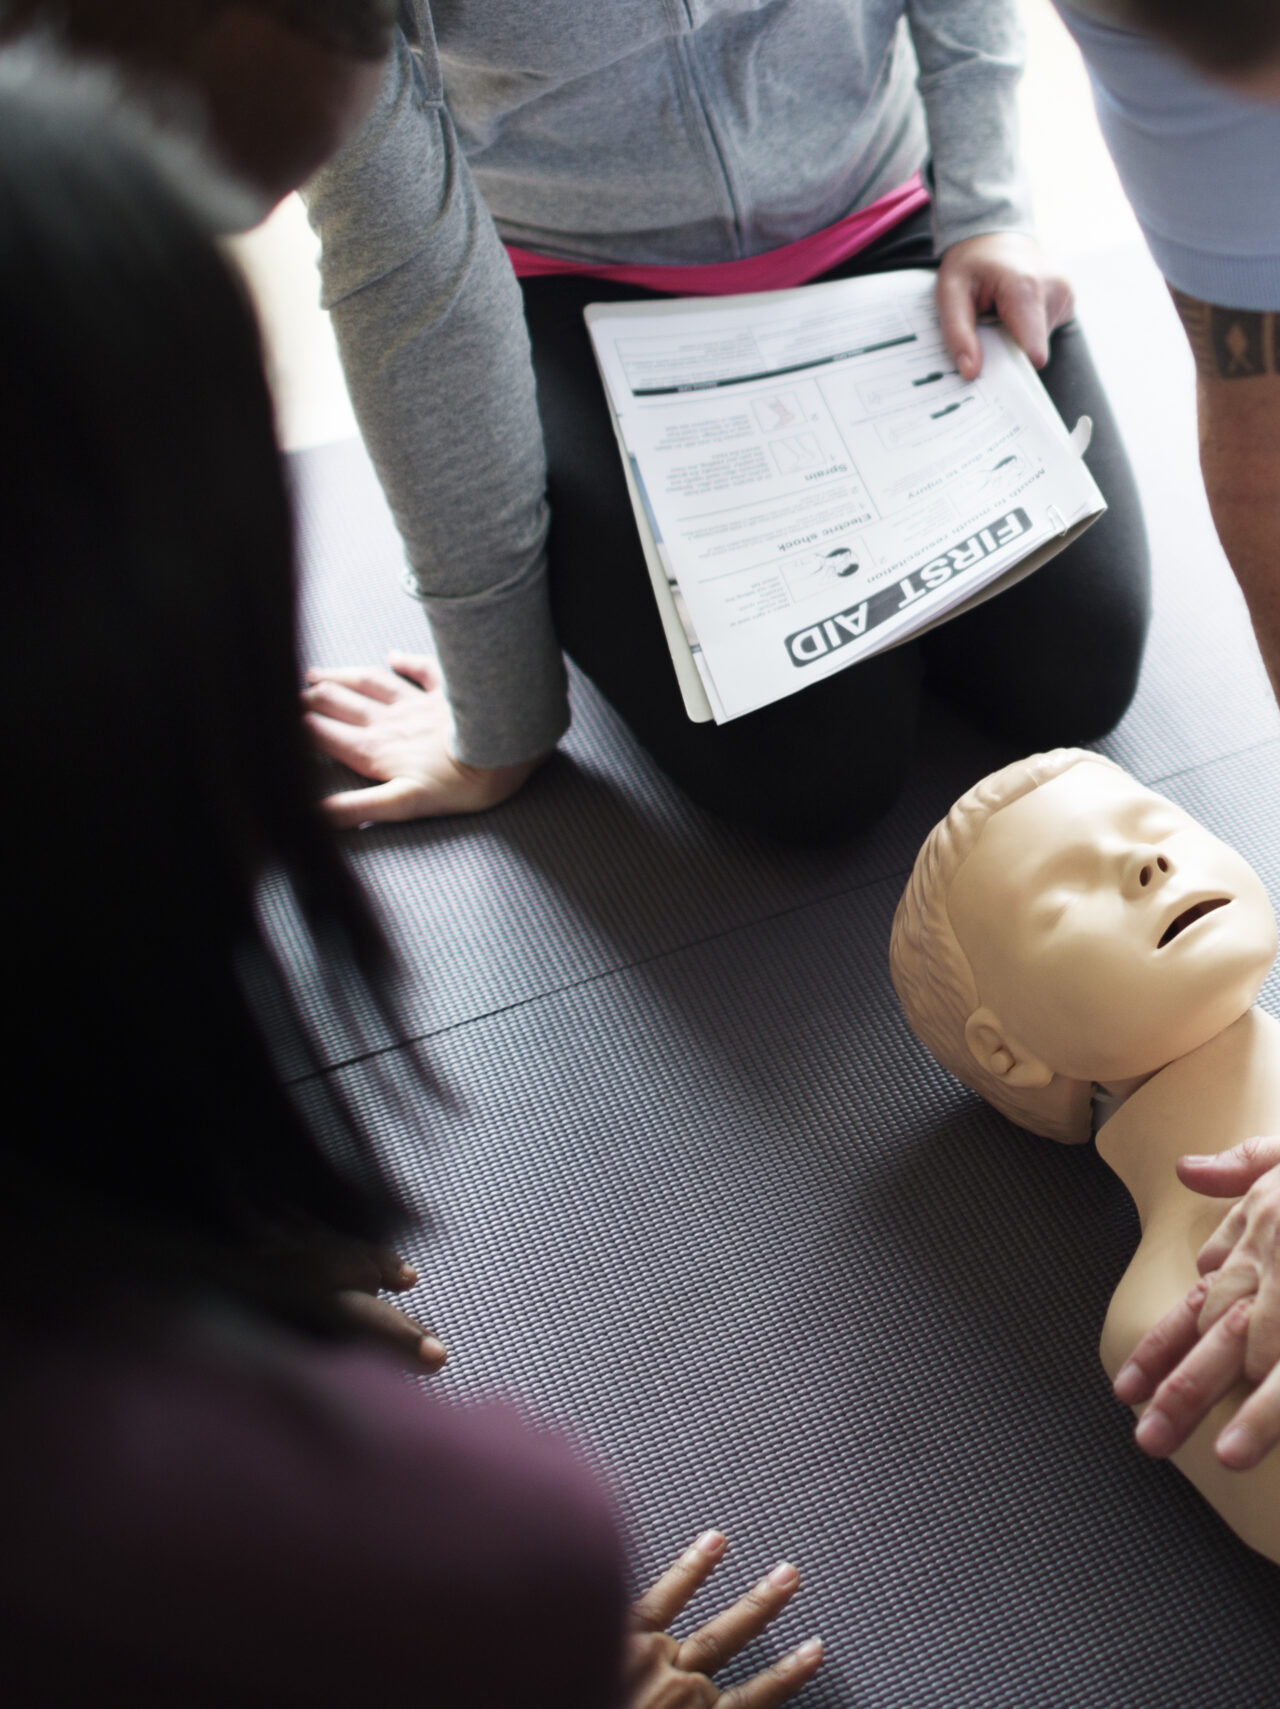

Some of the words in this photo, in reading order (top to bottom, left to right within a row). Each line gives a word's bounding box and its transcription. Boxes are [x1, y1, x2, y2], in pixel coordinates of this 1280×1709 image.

[988, 425, 1020, 453] Shock
[804, 464, 848, 481] Sprain
[945, 469, 958, 479] to
[1009, 468, 1046, 498] Mouth
[908, 478, 943, 499] injury
[994, 497, 1006, 508] to
[823, 513, 872, 535] Electric
[951, 507, 991, 534] mouth
[778, 533, 818, 551] shock
[867, 534, 949, 583] resuscitation
[898, 511, 1024, 609] FIRST
[791, 602, 869, 661] AID
